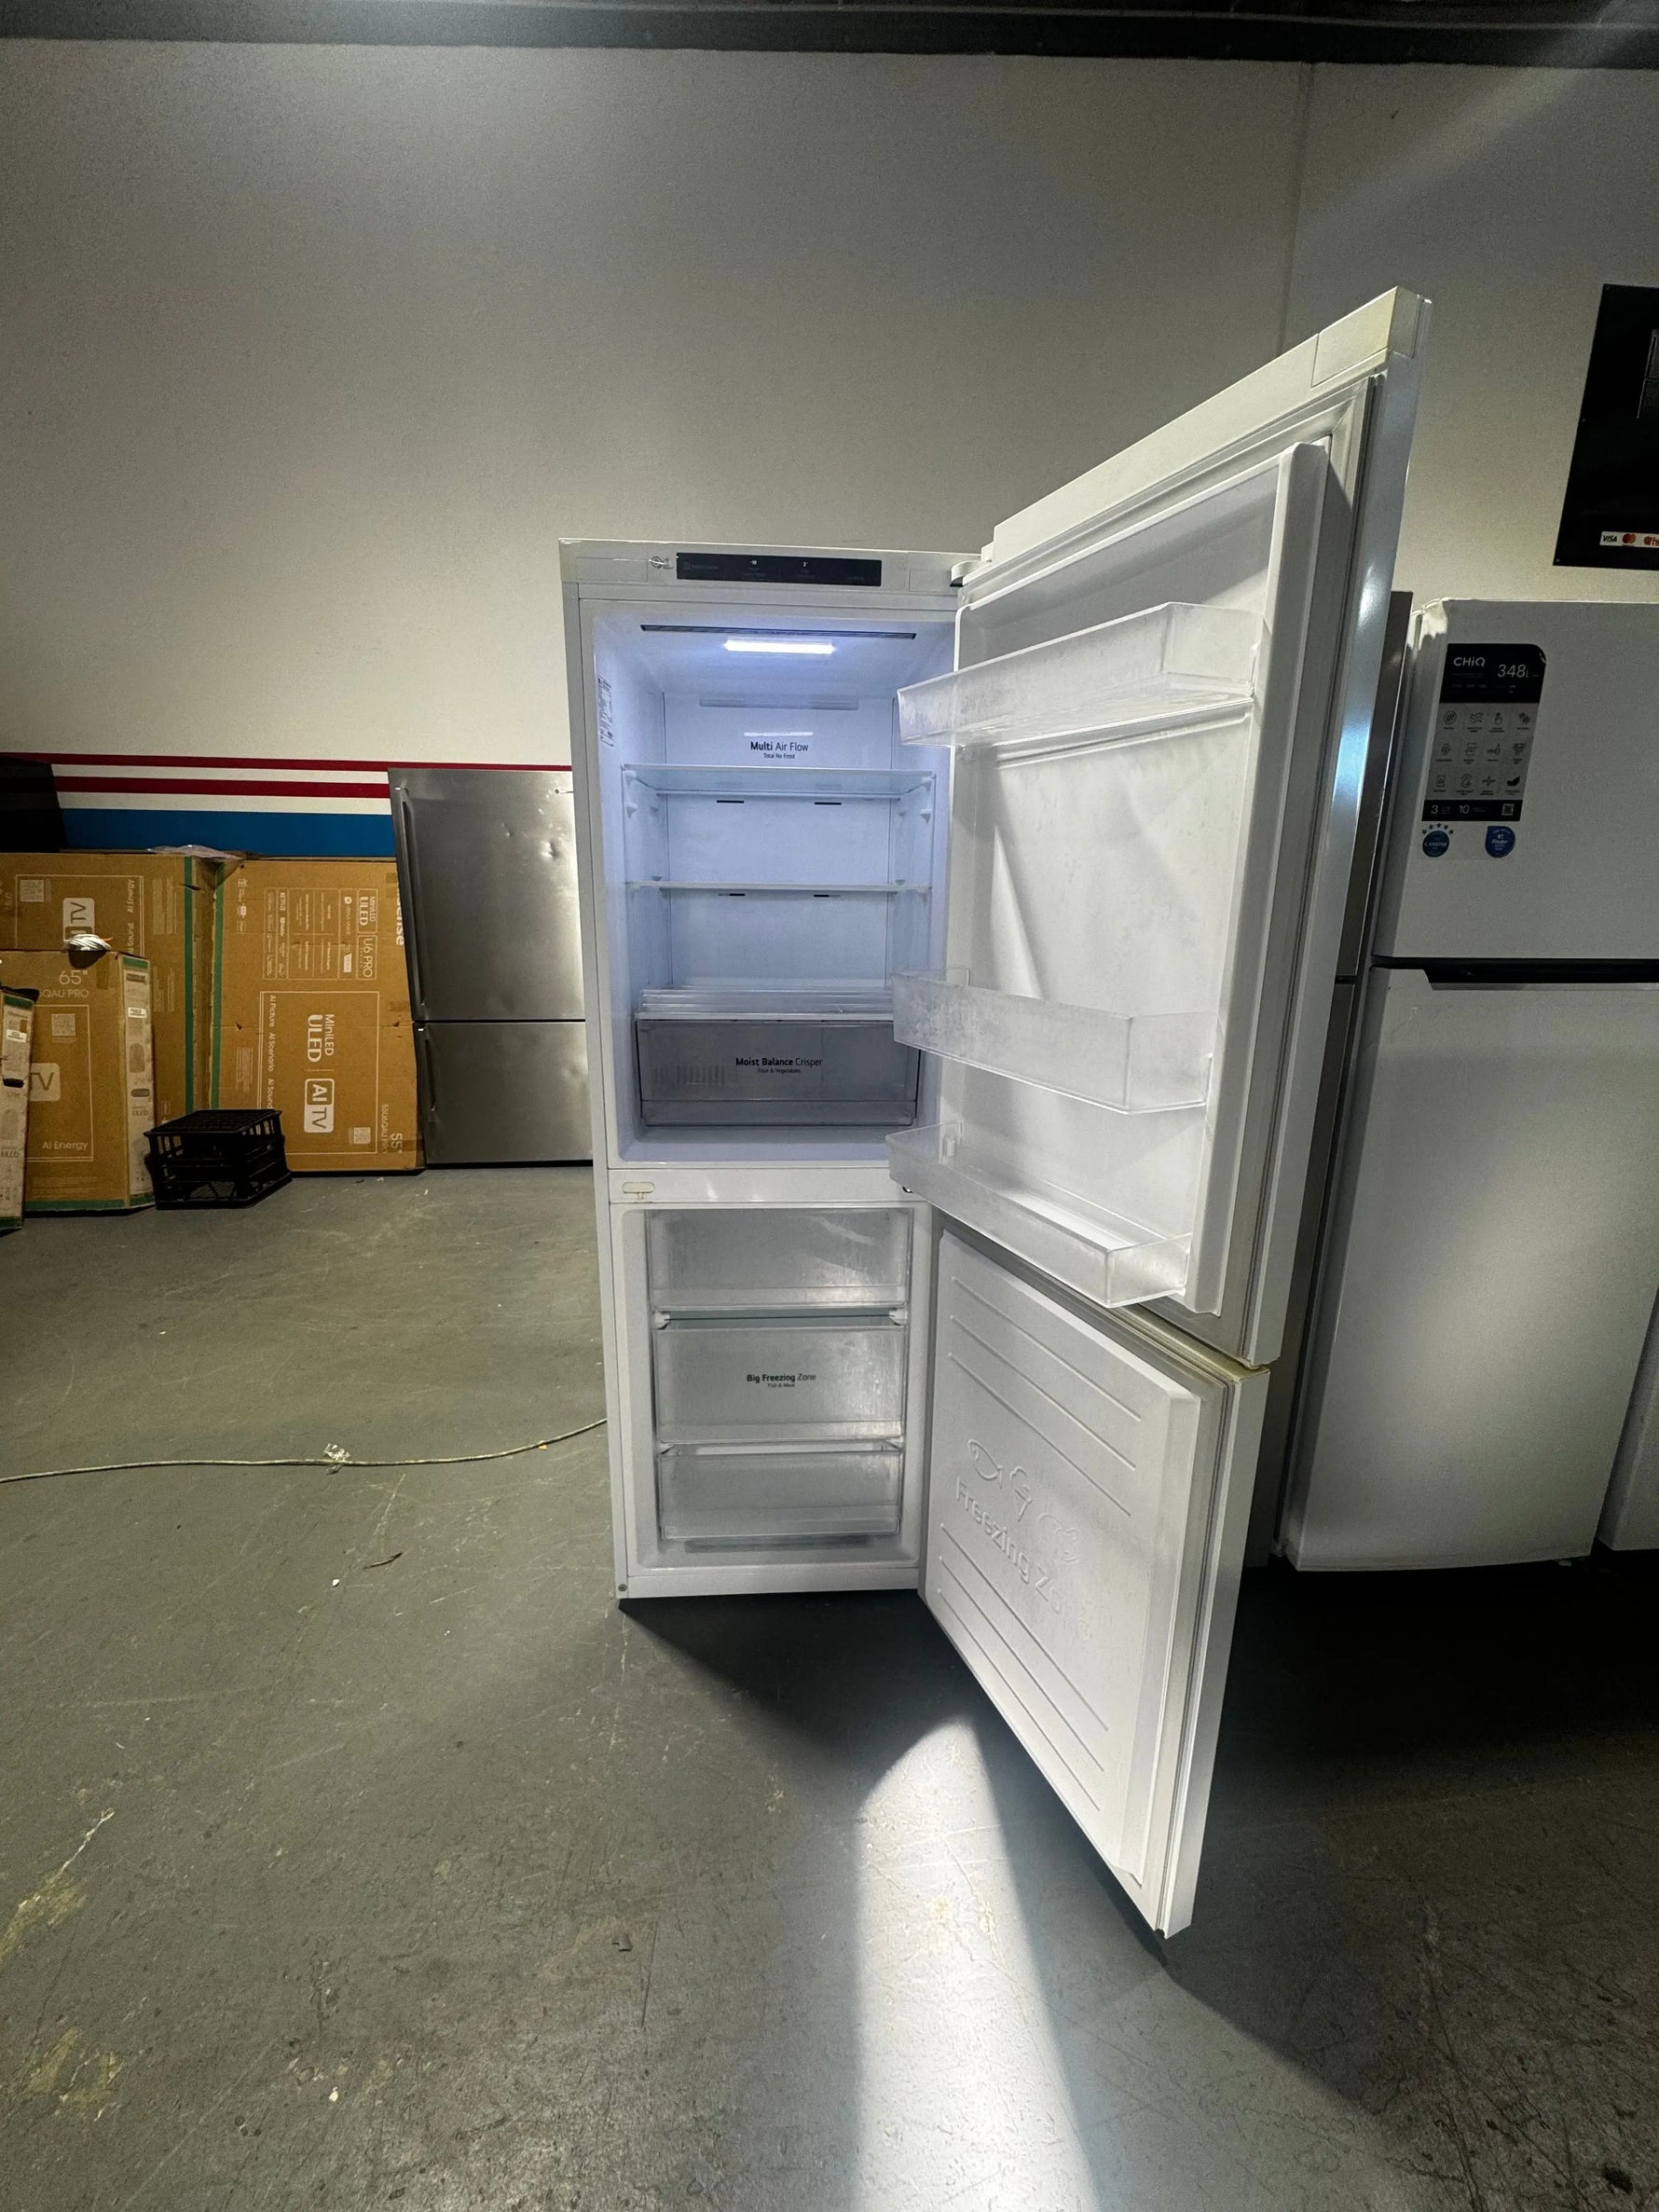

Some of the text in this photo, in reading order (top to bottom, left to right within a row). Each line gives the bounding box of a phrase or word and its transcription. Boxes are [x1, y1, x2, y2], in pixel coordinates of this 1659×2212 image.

[750, 741, 809, 752] Multi Air Flow
[71, 901, 87, 924] TV
[359, 897, 368, 926] ULED
[363, 938, 373, 978] U6 PRO
[59, 969, 89, 985] 65"
[67, 988, 89, 998] PRO
[268, 1002, 277, 1027] Picture
[307, 1014, 323, 1063] ULED
[324, 1013, 335, 1056] MiniLED
[267, 1040, 276, 1072] Scenario
[735, 1057, 823, 1067] Moist Balance Crisper
[311, 1084, 327, 1129] AI TV
[42, 1141, 89, 1151] AI Energy
[747, 1373, 816, 1383] Big Freezing Zone
[955, 1476, 1031, 1585] Freezing
